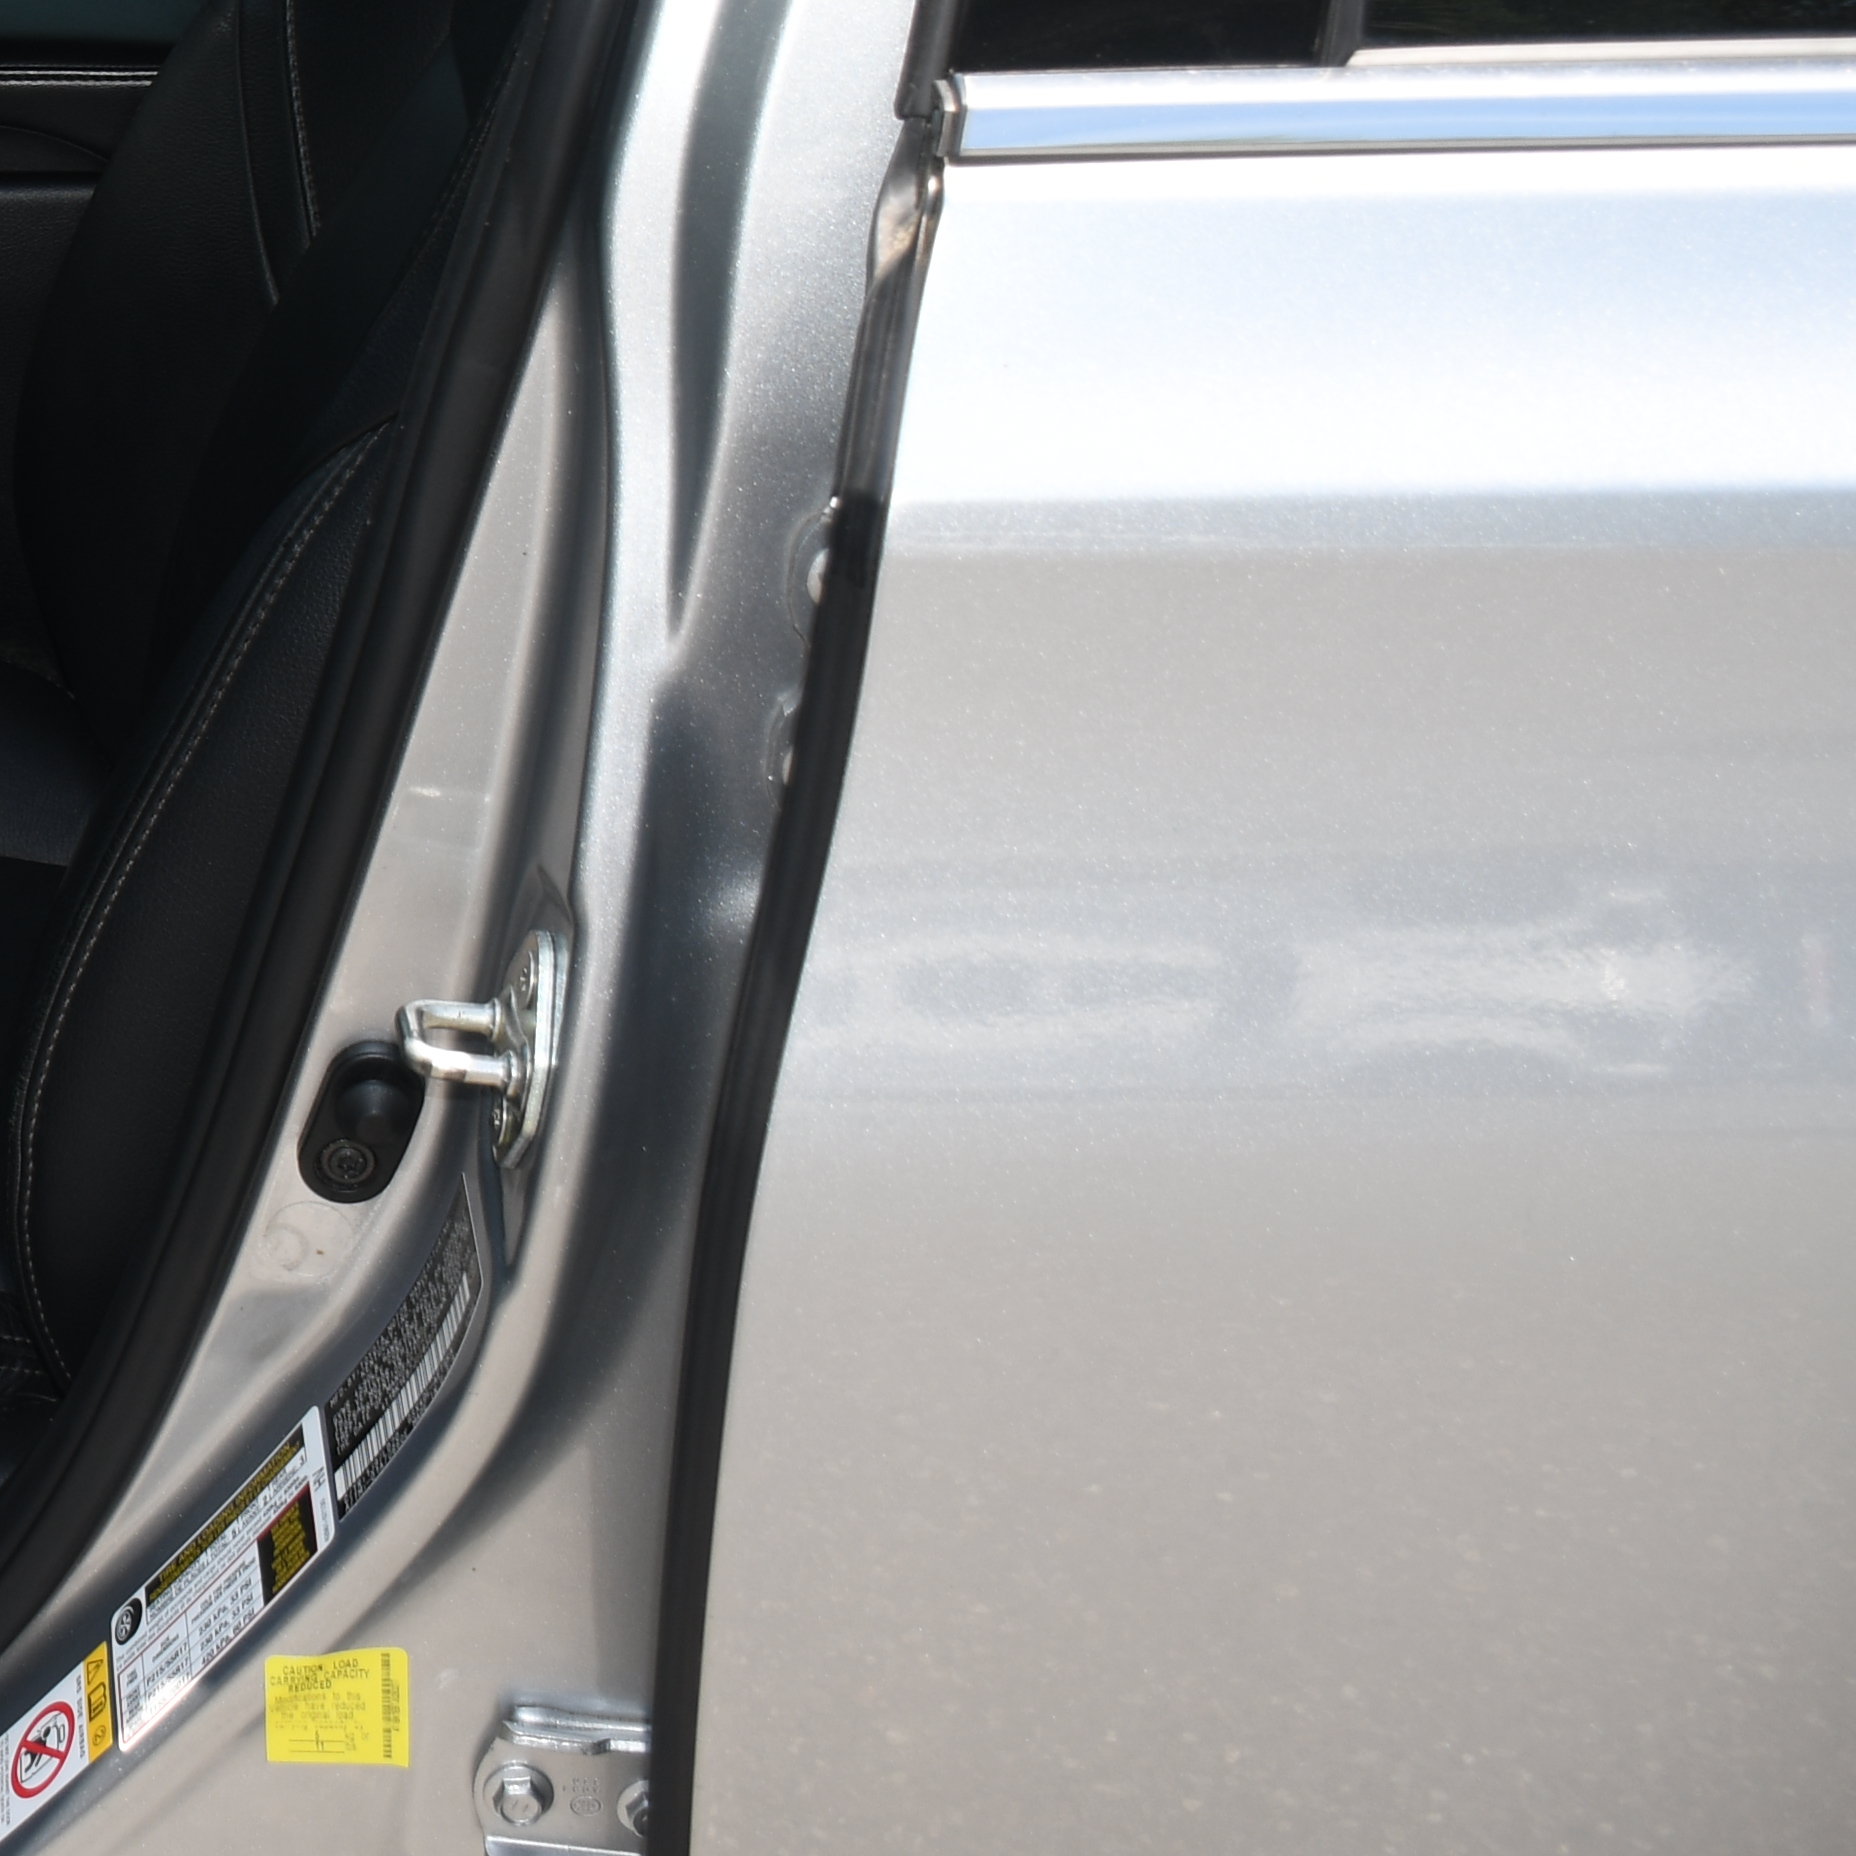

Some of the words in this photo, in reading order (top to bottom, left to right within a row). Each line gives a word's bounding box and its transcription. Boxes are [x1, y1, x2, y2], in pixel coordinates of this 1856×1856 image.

[333, 1658, 358, 1669] LOAD
[270, 1672, 318, 1686] CARRYING
[323, 1669, 369, 1679] CAPACITY
[288, 1679, 331, 1692] REDUCED
